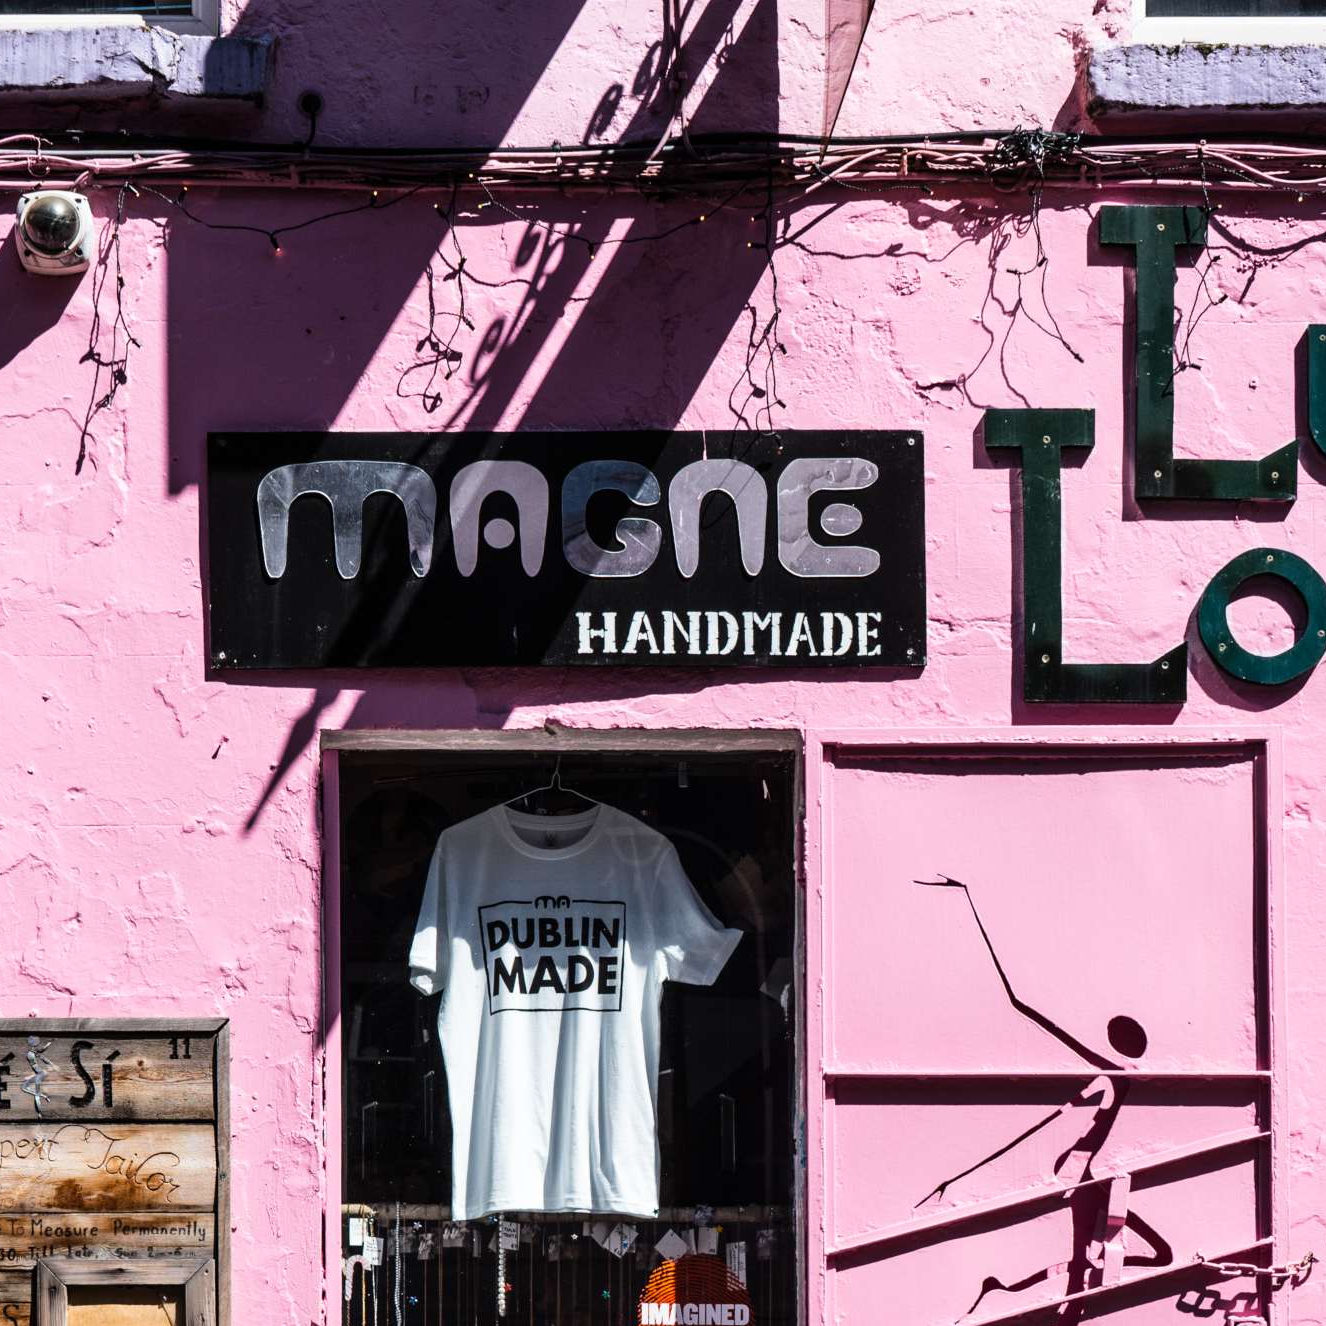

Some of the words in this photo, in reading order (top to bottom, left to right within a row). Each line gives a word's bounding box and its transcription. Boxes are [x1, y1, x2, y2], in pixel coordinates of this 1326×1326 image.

[577, 610, 881, 656] HANDMADE
[486, 917, 620, 952] DUBLIN
[493, 955, 618, 997] MADE
[86, 1127, 180, 1202] Tailor
[8, 1219, 24, 1236] To
[31, 1219, 98, 1237] Measure
[113, 1219, 206, 1241] Permanently
[641, 1303, 749, 1325] IMAGINED
